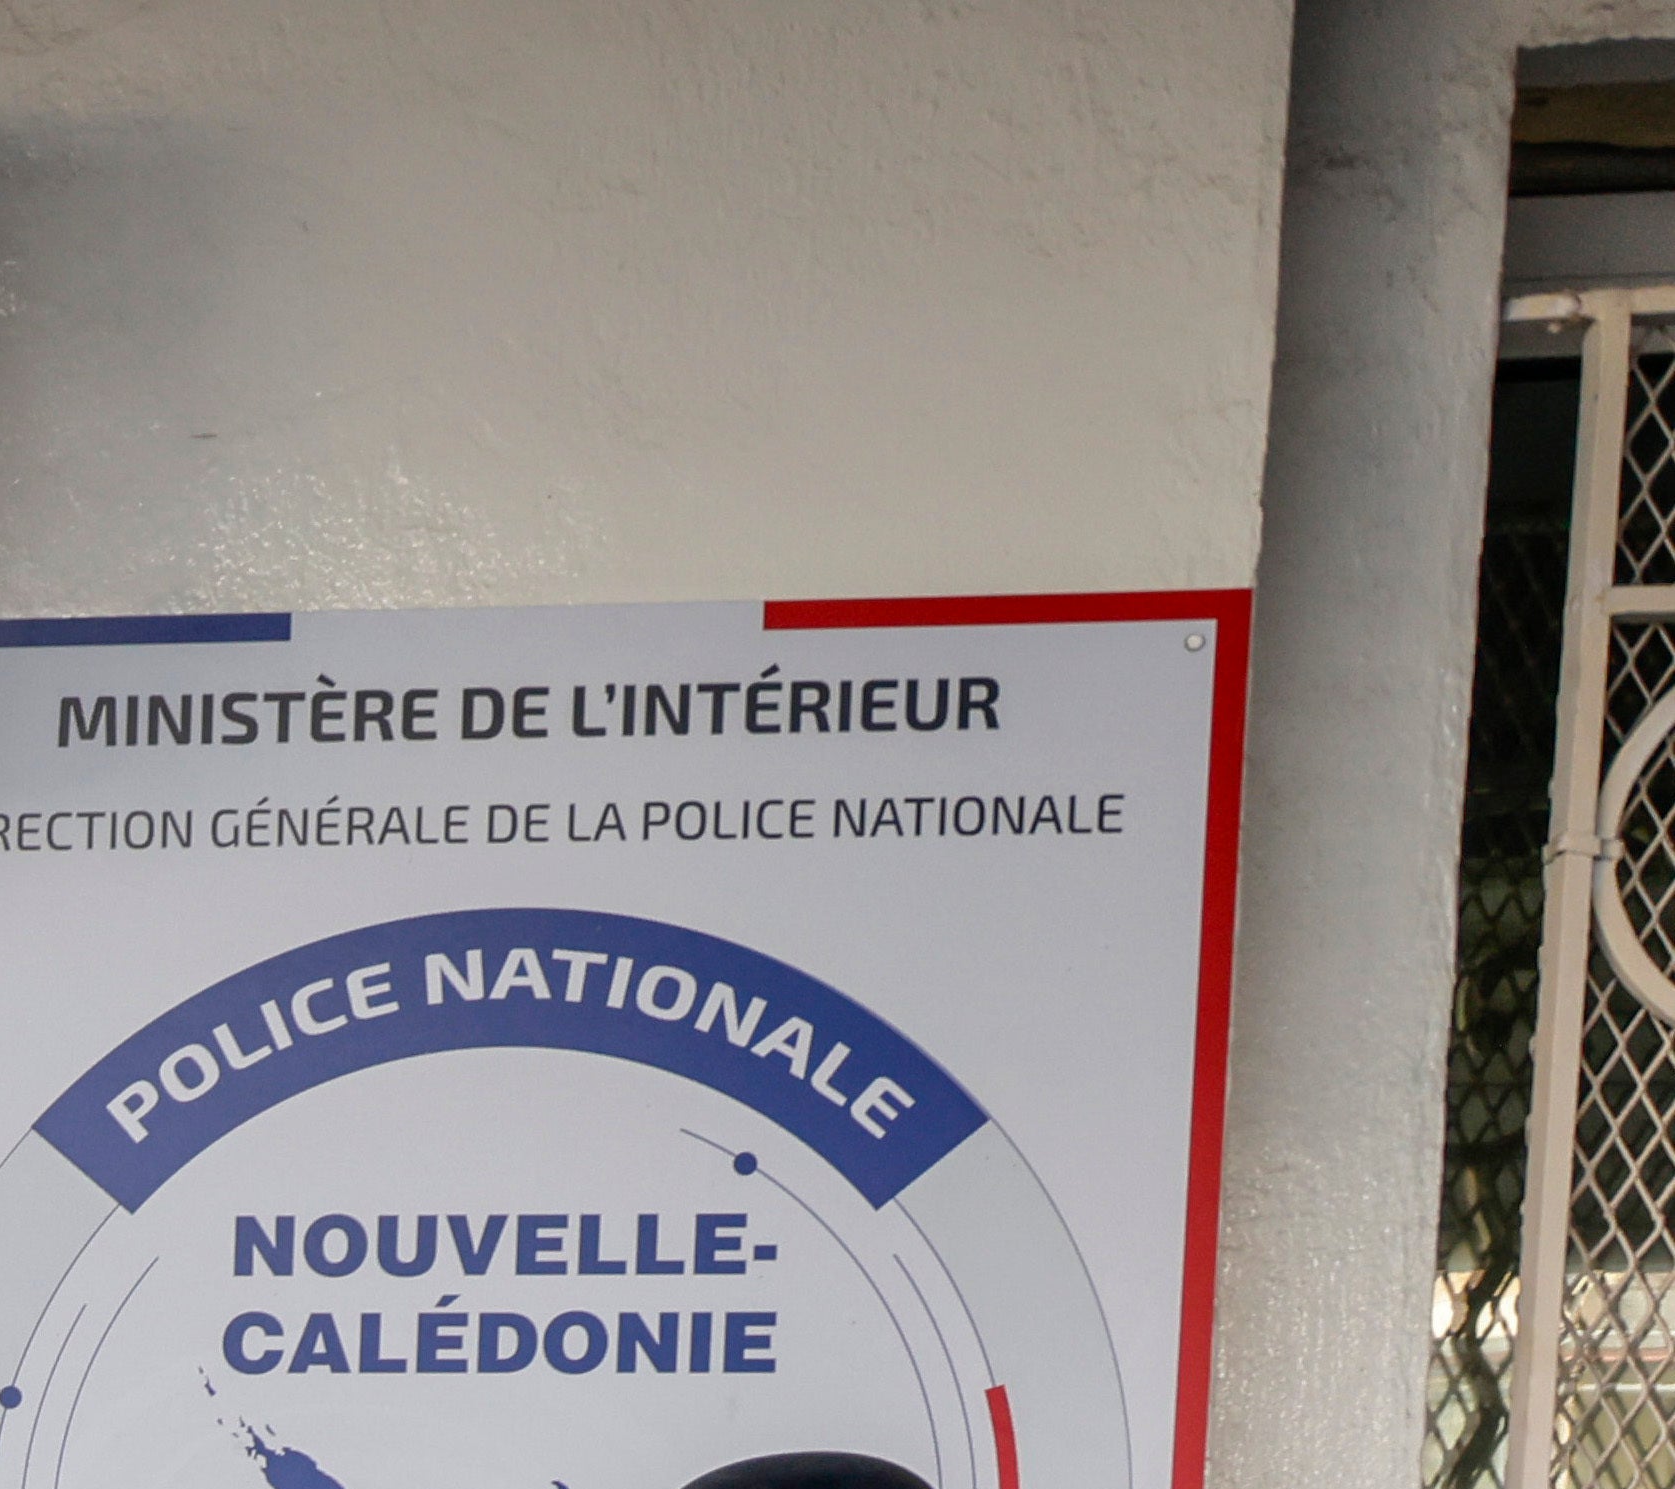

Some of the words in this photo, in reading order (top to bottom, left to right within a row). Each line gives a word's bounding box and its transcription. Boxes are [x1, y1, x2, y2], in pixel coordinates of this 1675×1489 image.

[58, 673, 439, 748] MINISTÈRE
[461, 686, 550, 740] DE
[572, 665, 1000, 738] L'INTÉRIEUR
[211, 795, 470, 848] GÉNÉRALE
[487, 804, 550, 844] DE
[568, 802, 627, 842] LA
[642, 799, 816, 841] POLICE
[833, 794, 1125, 838] NATIONALE
[105, 961, 400, 1145] POLICE
[424, 945, 917, 1141] NATIONALE
[233, 1213, 778, 1278] NOUVELLE-
[222, 1294, 777, 1375] CALÉDONIE
